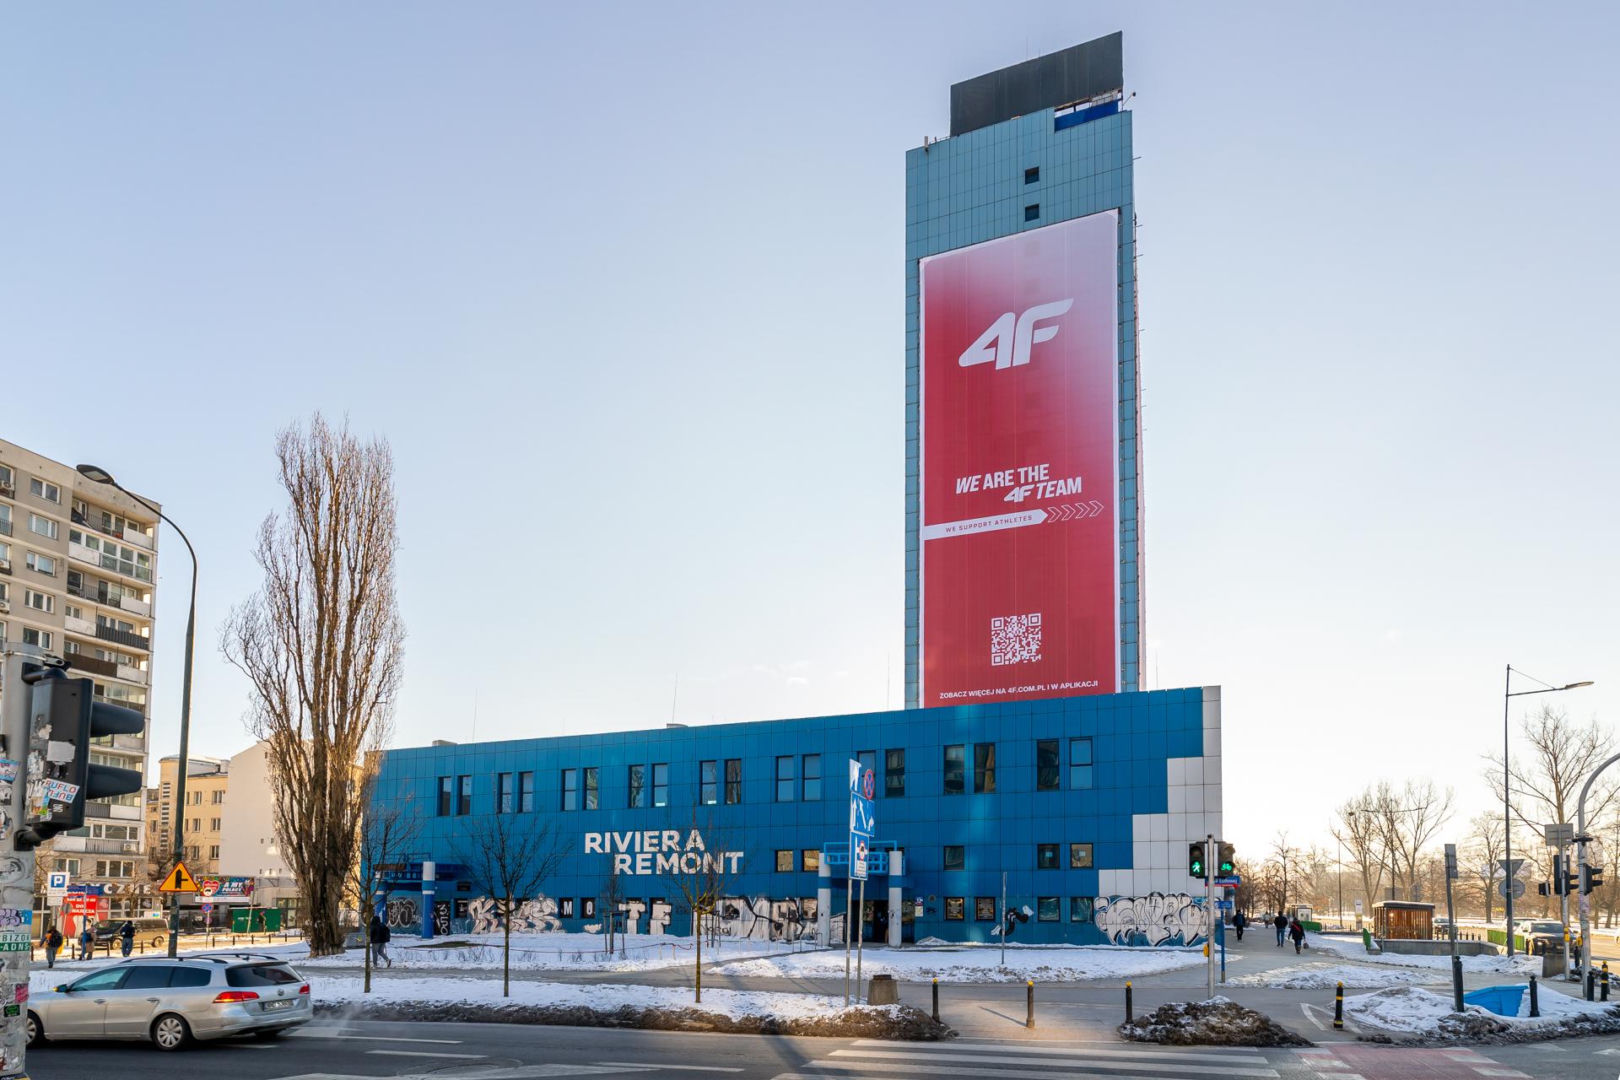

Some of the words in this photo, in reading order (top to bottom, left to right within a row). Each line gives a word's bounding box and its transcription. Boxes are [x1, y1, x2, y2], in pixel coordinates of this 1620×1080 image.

[958, 298, 1074, 370] 4F
[956, 475, 981, 494] WE
[983, 469, 1014, 490] ARE
[1017, 463, 1050, 484] THE
[1003, 484, 1034, 503] 4F
[1036, 477, 1082, 500] TEAM
[945, 525, 956, 533] WE
[959, 520, 992, 531] SUPPORT
[994, 515, 1033, 526] ATHLETES
[939, 691, 967, 699] ZOBACZ
[968, 689, 995, 698] WIĘCEJ
[1007, 685, 1046, 694] 4F.COM.PL
[1059, 680, 1099, 689] APLIKACJI
[584, 829, 706, 854] RIVIERA
[613, 851, 744, 875] REMONT
[54, 876, 64, 887] P
